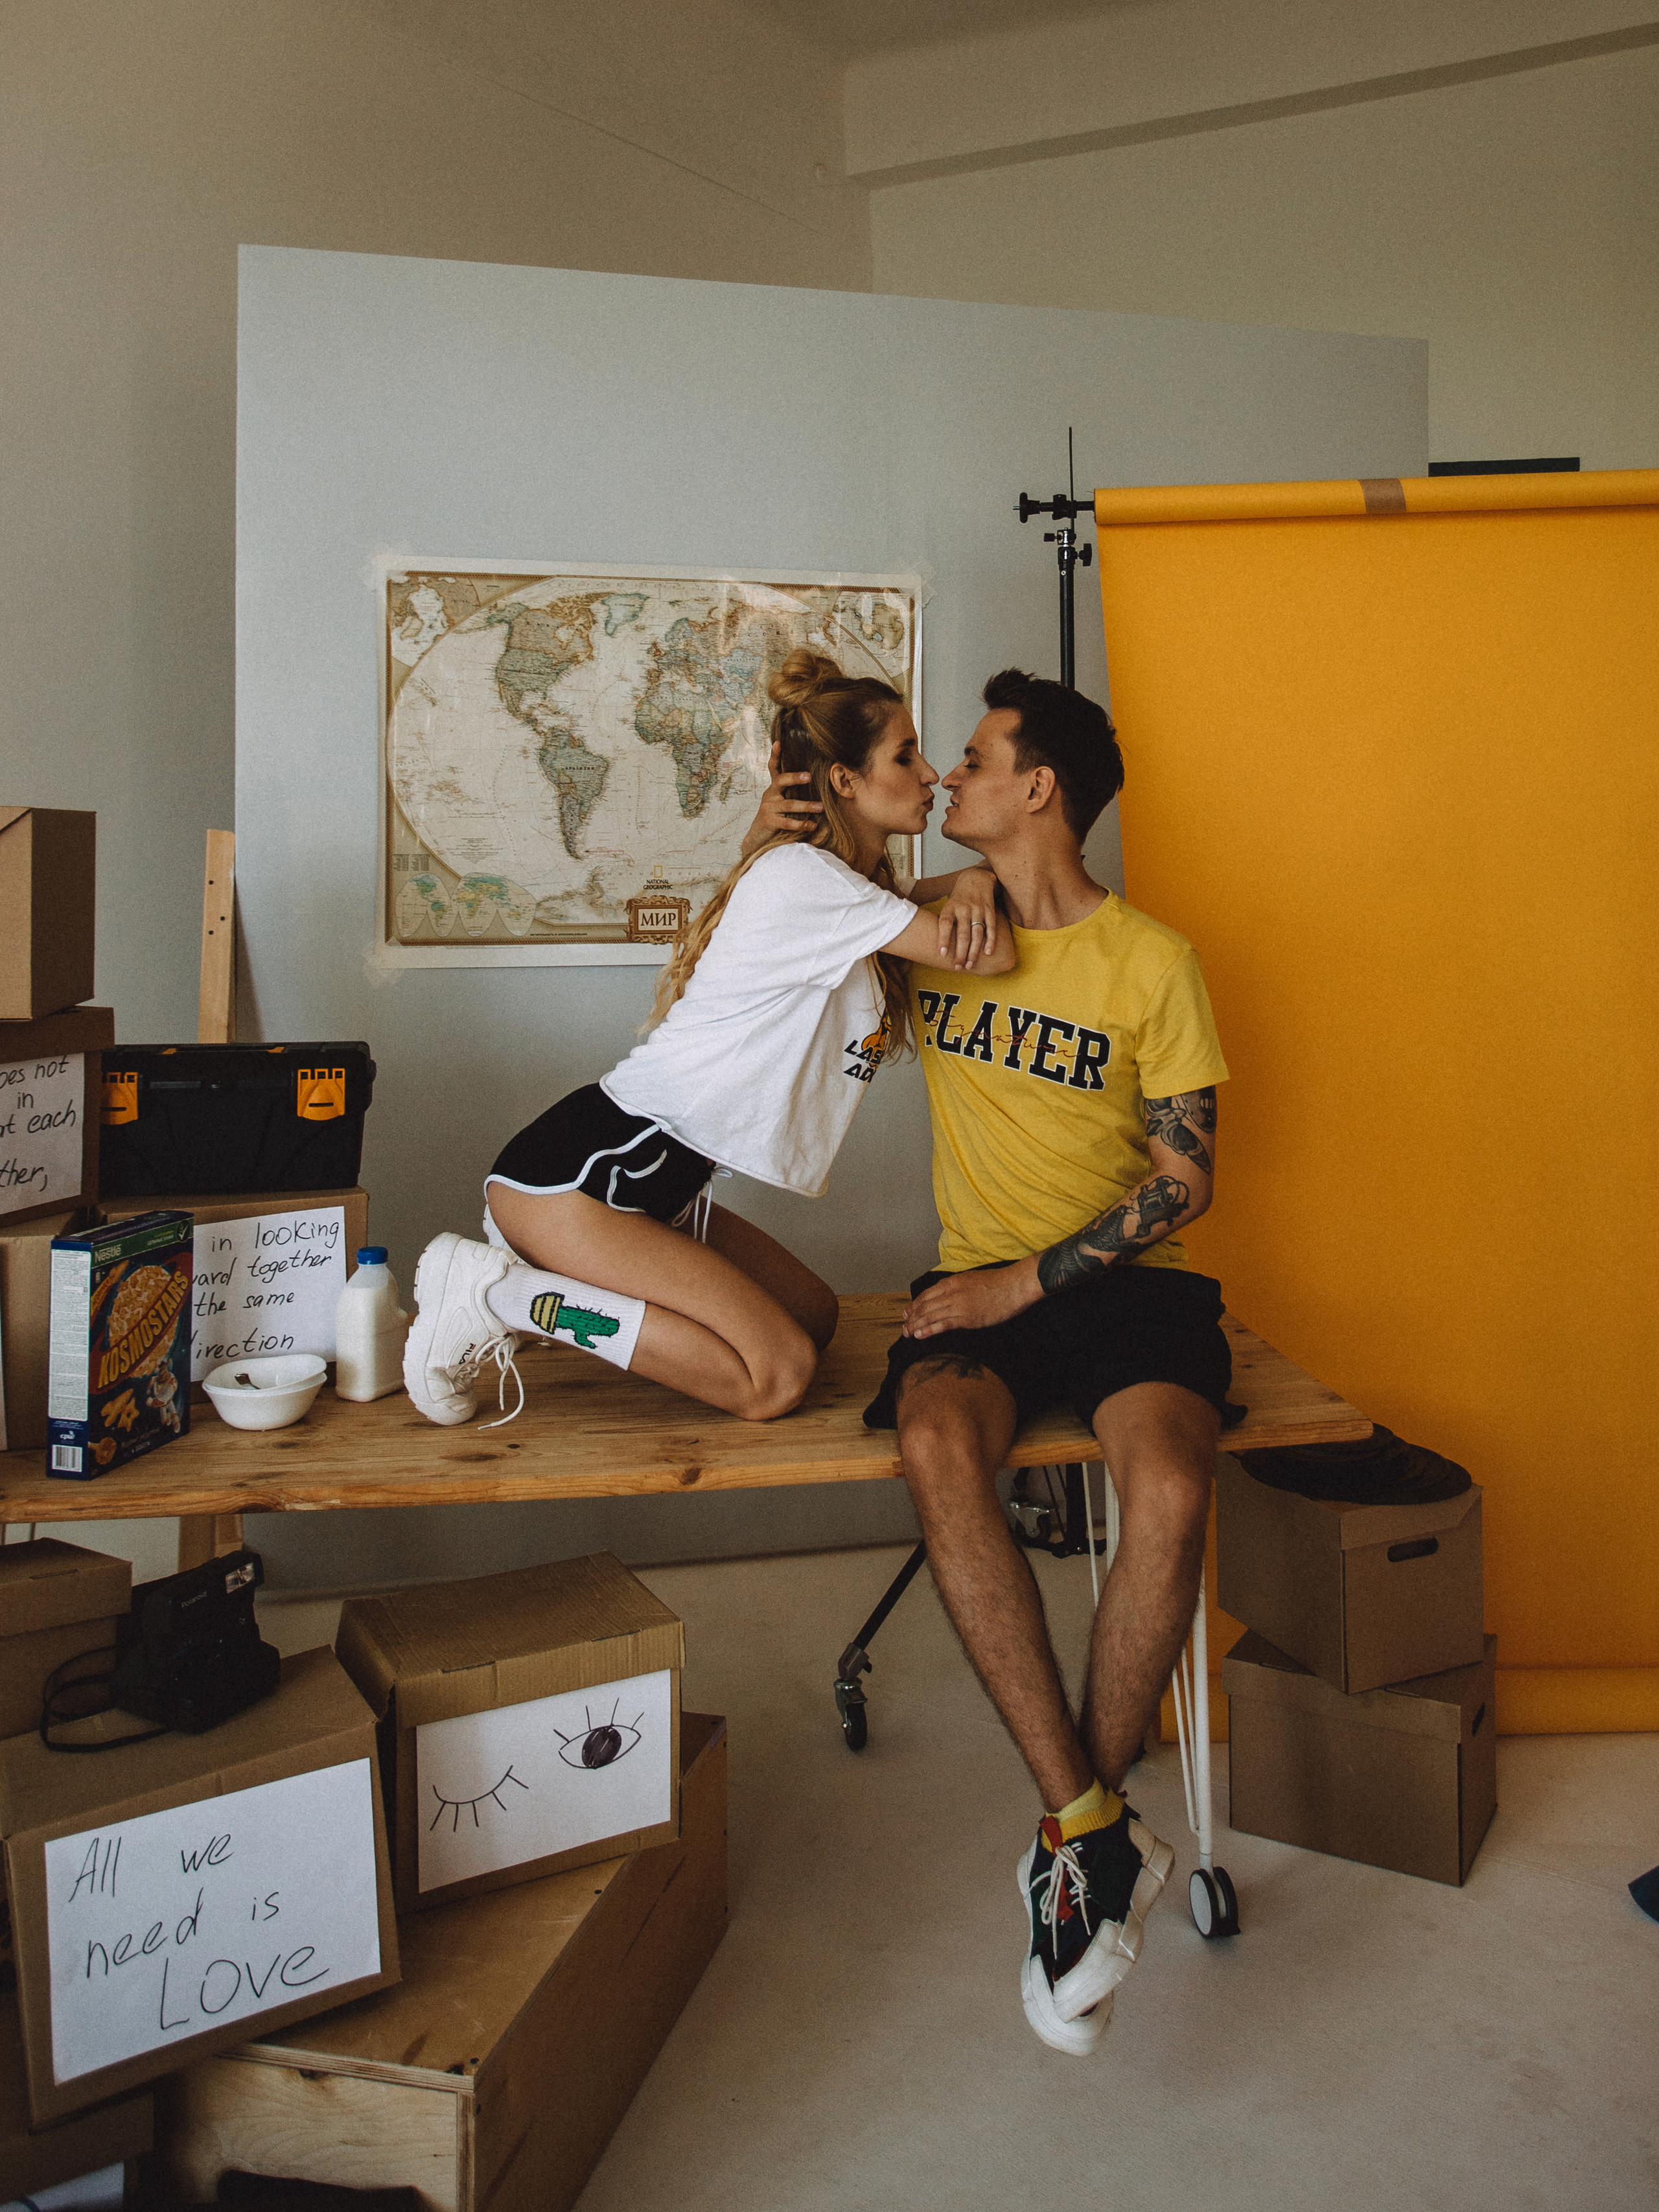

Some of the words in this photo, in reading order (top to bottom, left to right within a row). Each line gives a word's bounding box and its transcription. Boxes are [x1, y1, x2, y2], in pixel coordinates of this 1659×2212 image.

[640, 913, 677, 926] МИР
[918, 989, 1111, 1091] PLAYER
[844, 1040, 885, 1065] LAS
[34, 1056, 69, 1080] not
[843, 1063, 877, 1083] AD
[17, 1092, 34, 1109] in
[27, 1099, 76, 1134] each
[211, 1237, 238, 1252] in
[193, 1257, 237, 1286] ard
[247, 1249, 332, 1283] together
[194, 1292, 227, 1316] the
[242, 1292, 294, 1309] same
[98, 1270, 189, 1389] KOSMOSTARS
[459, 1343, 476, 1364] FILA
[181, 1590, 207, 1608] Polaroid
[69, 1836, 122, 1903] All
[181, 1834, 235, 1874] we
[87, 1887, 204, 1979] need
[251, 1891, 279, 1922] is
